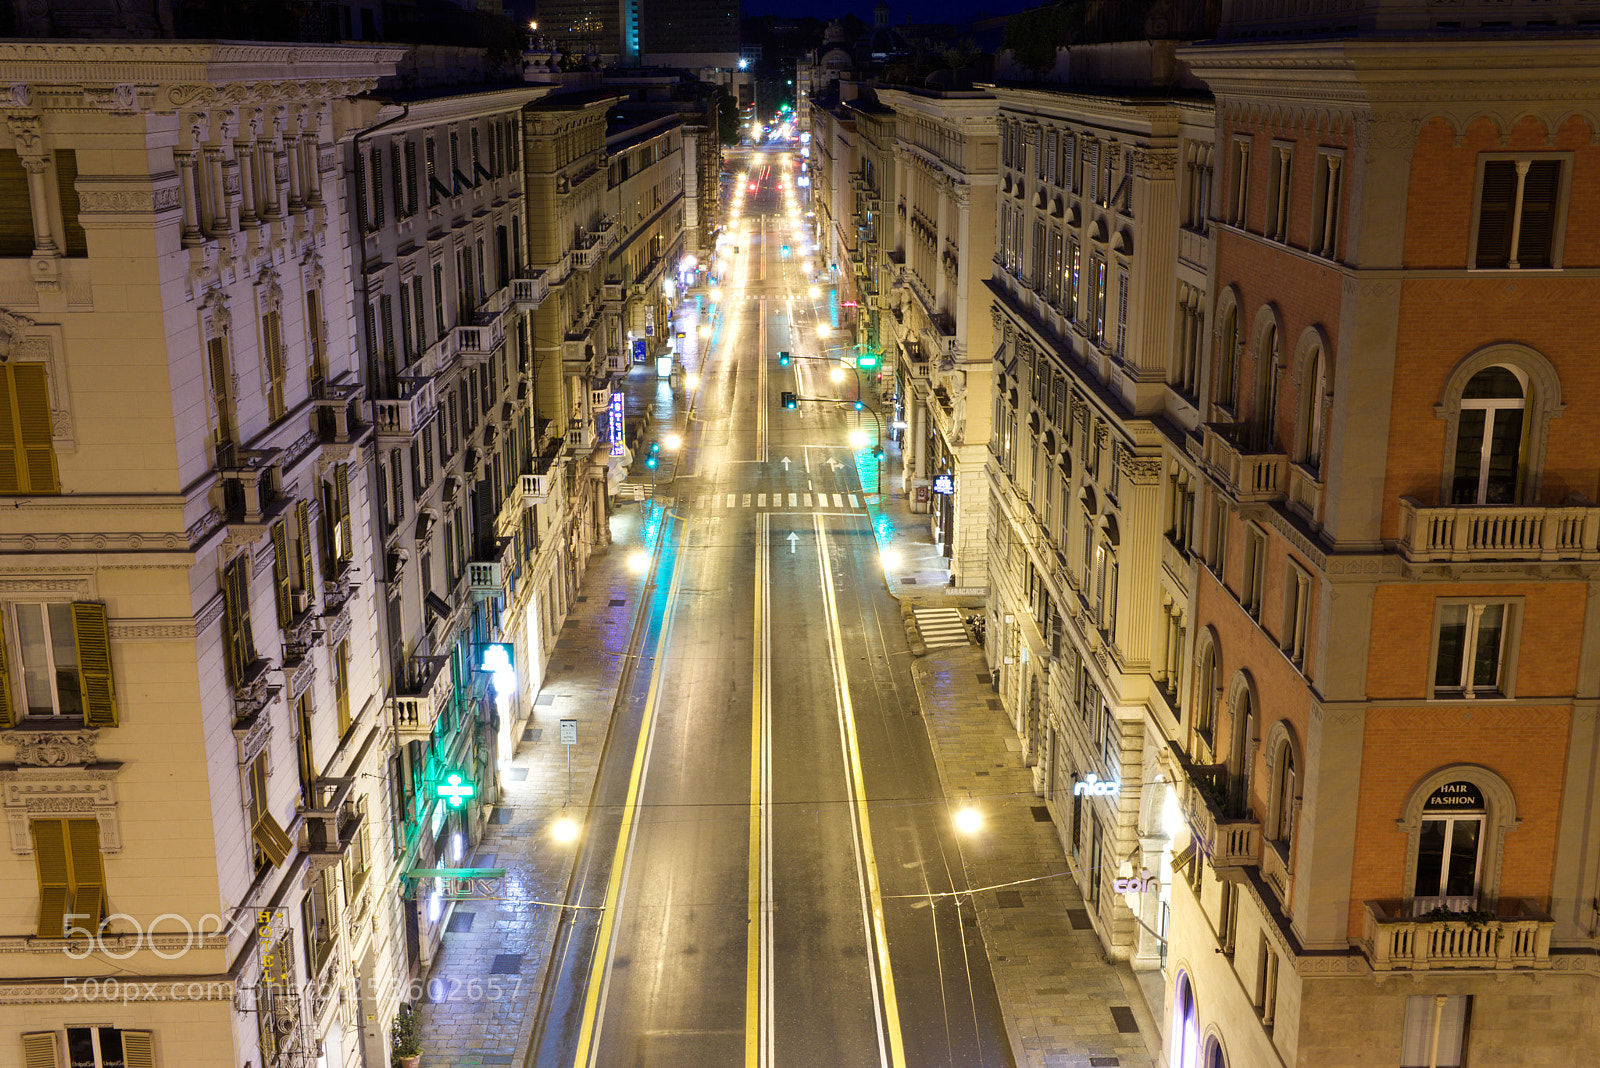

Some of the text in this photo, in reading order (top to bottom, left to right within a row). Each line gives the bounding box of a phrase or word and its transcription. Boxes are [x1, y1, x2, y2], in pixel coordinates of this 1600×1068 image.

[1440, 784, 1468, 793] HAIR
[1430, 796, 1476, 805] FASHION
[1113, 867, 1161, 893] coin
[257, 911, 276, 983] HOTEL
